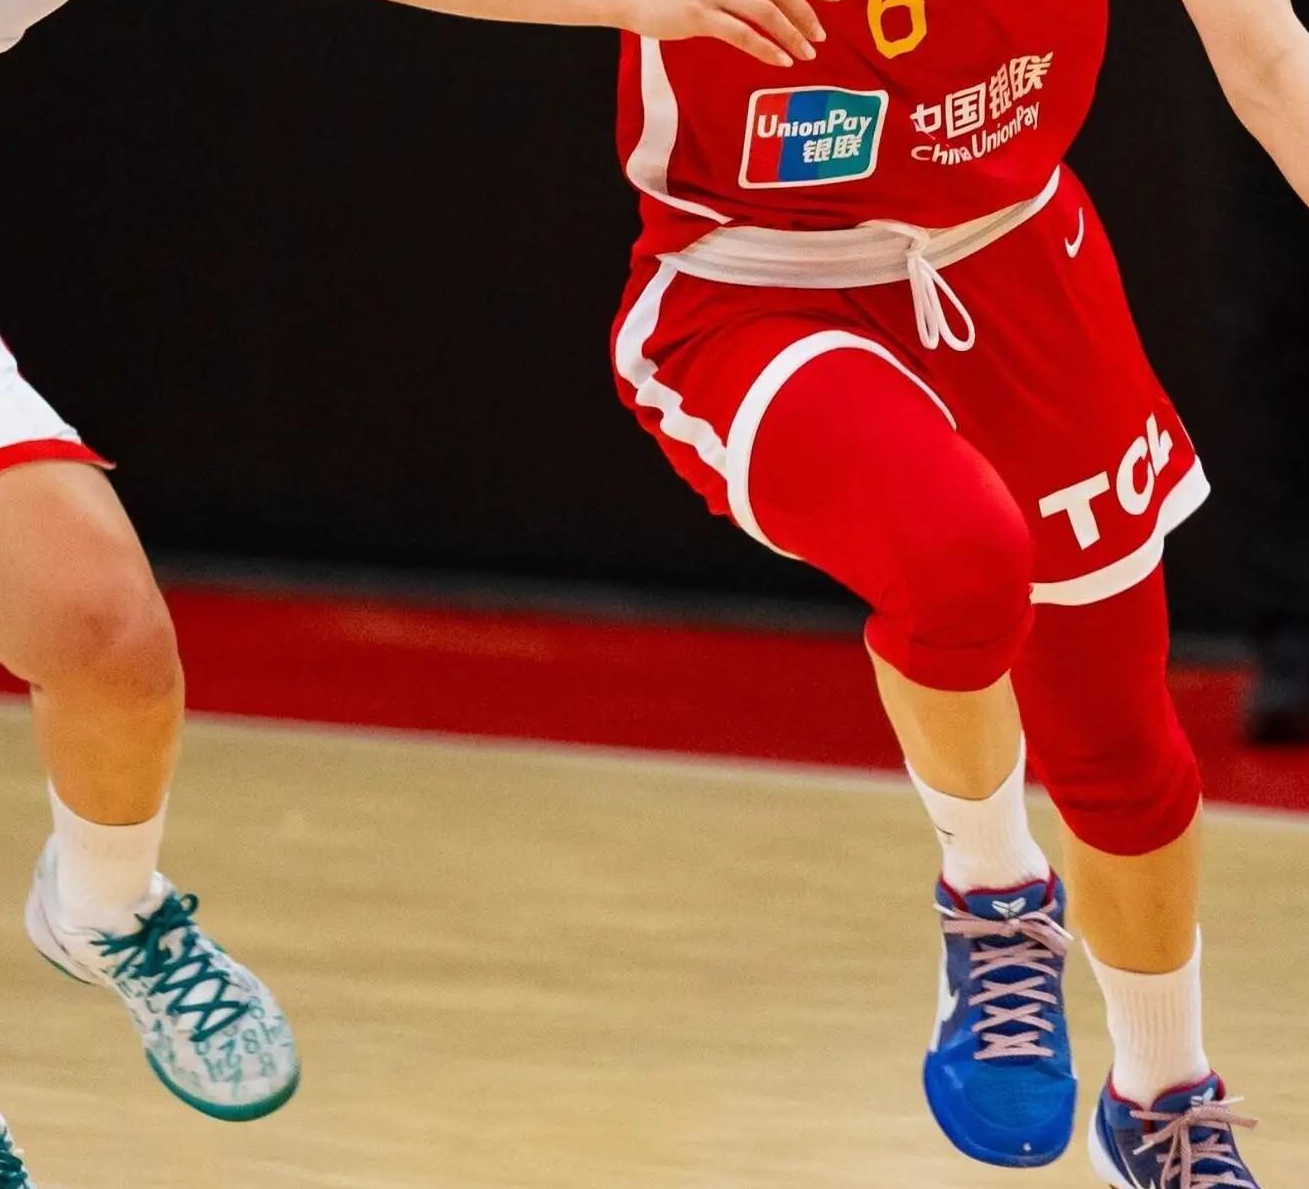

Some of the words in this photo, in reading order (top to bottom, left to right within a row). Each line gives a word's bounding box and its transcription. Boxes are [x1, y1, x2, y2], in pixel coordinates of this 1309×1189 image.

[756, 108, 872, 139] UnionPay
[909, 50, 1054, 140] 中国银联
[802, 134, 863, 163] 银联
[910, 143, 973, 166] China
[971, 101, 1040, 159] UnionPay
[1037, 411, 1174, 551] TCL
